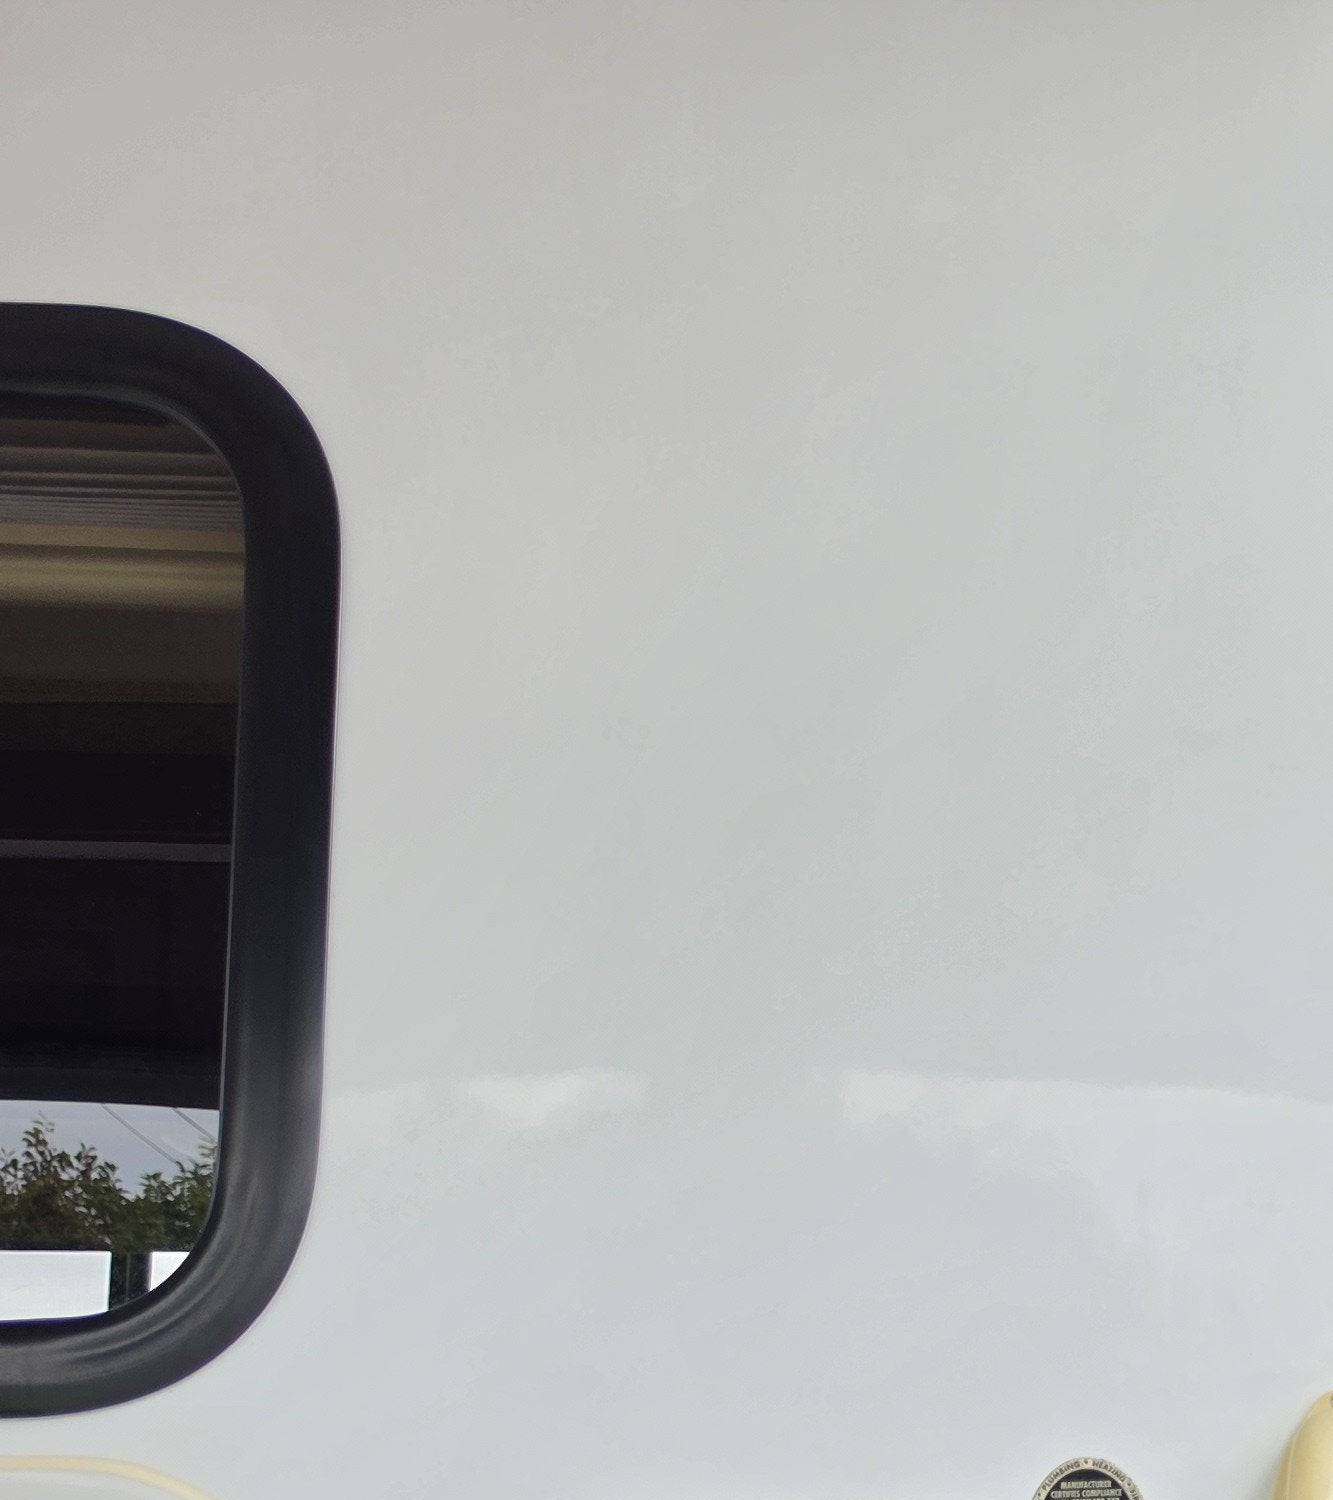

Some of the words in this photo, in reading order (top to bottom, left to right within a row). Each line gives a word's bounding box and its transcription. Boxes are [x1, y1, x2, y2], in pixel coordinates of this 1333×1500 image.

[1043, 1461, 1081, 1490] PLUMBING
[1093, 1461, 1126, 1483] HEATING
[1083, 1489, 1122, 1497] COMPLIANCE
